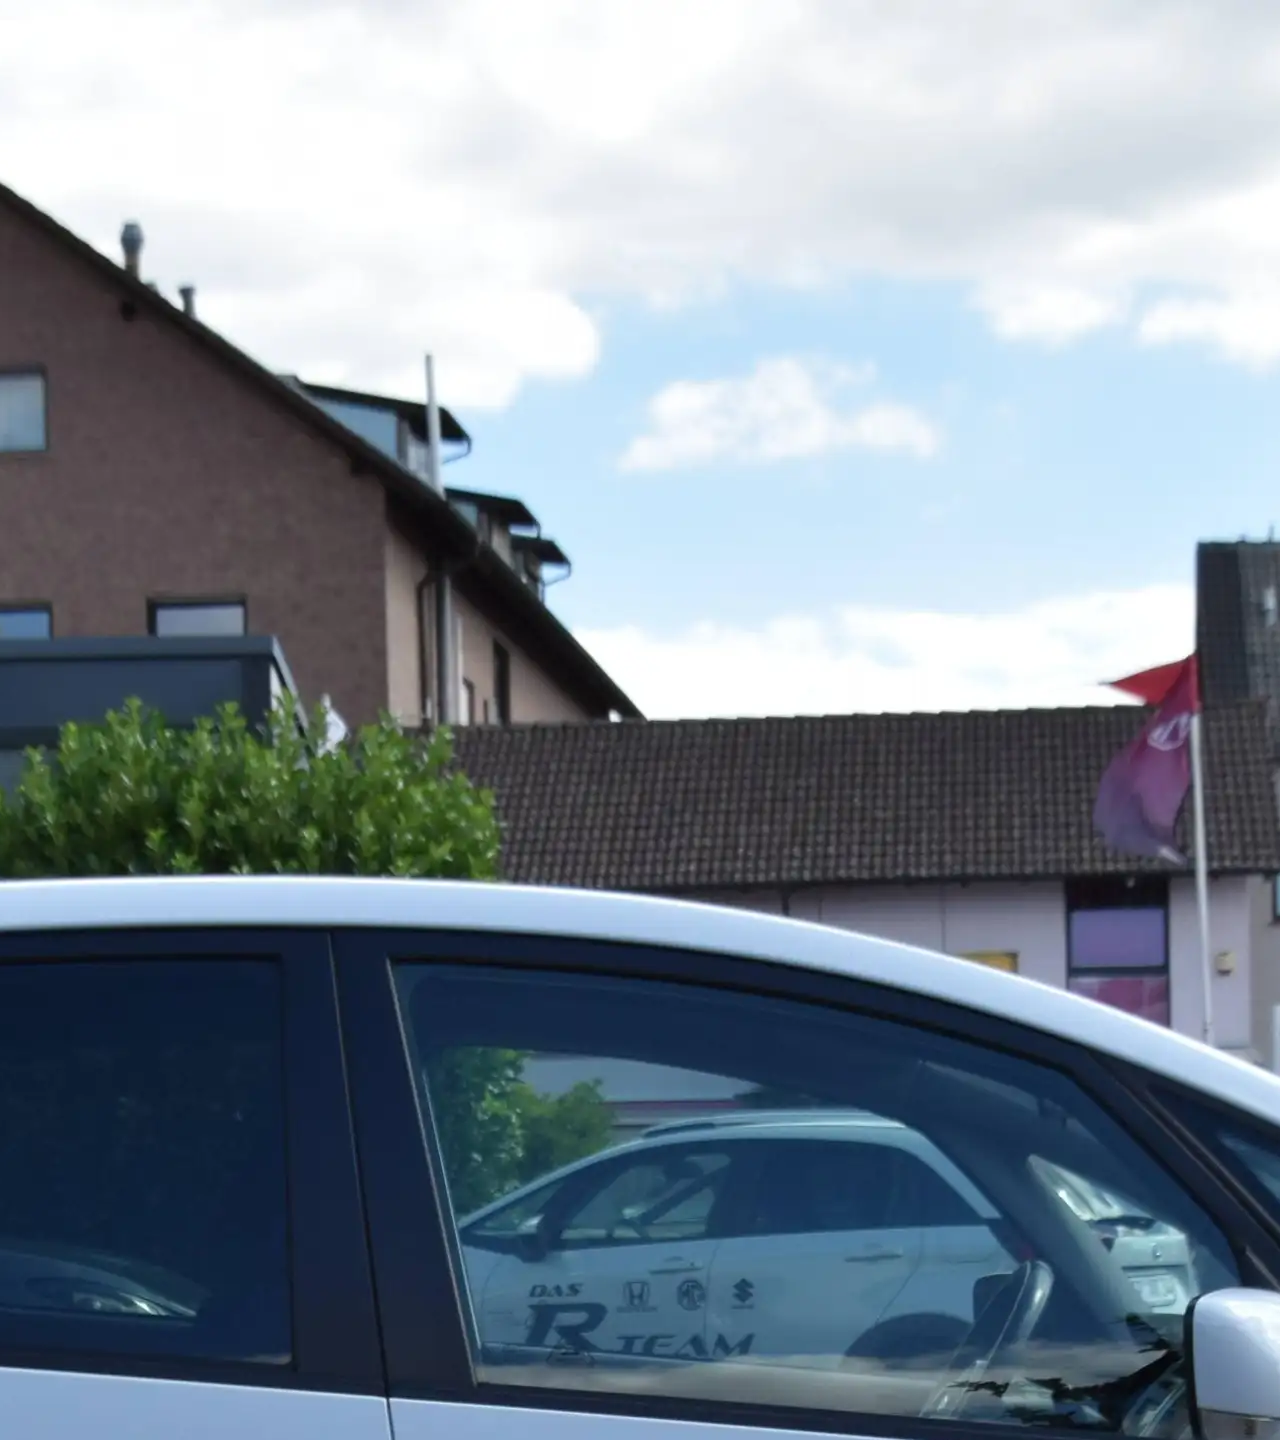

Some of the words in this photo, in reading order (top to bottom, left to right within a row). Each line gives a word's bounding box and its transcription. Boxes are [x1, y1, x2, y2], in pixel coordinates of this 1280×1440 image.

[528, 1282, 584, 1298] DAS
[525, 1302, 609, 1352] R
[616, 1333, 756, 1358] TEAM
